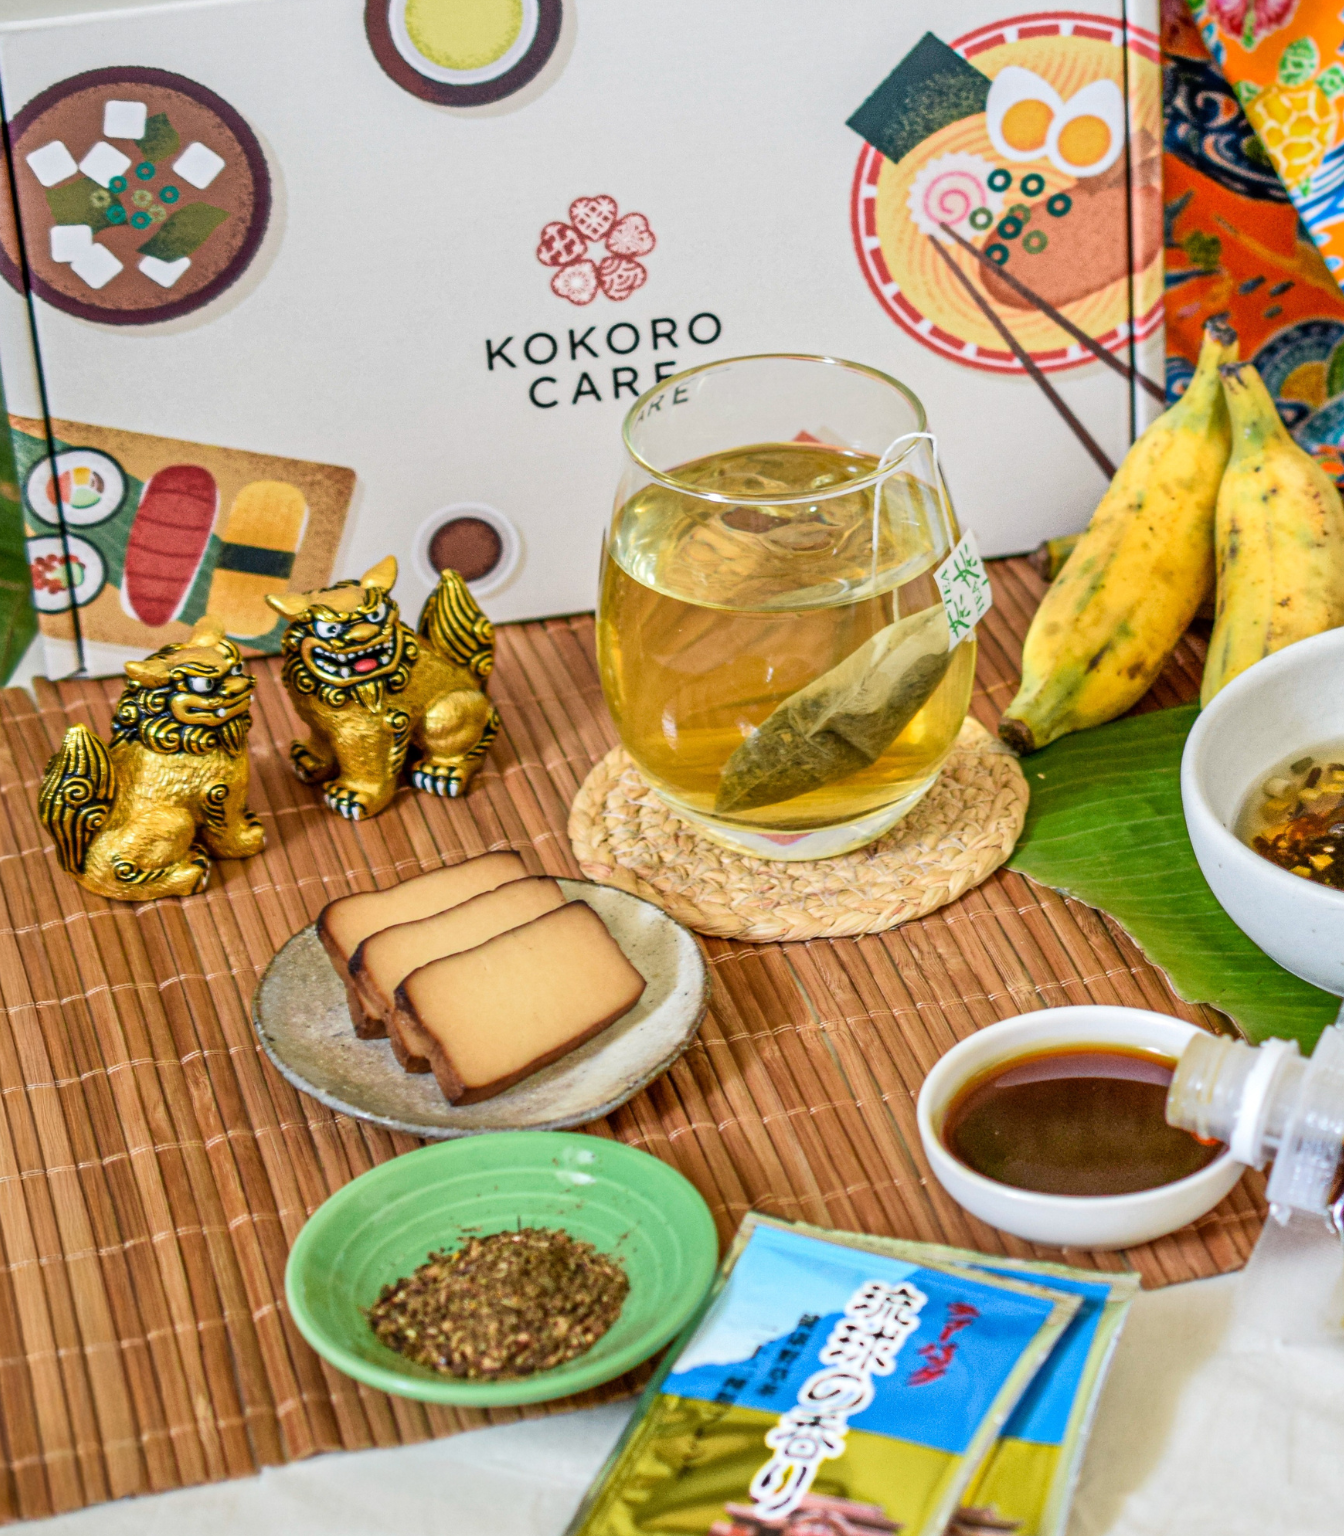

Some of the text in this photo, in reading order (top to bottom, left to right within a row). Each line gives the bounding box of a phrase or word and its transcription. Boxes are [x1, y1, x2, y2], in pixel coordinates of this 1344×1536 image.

[486, 312, 722, 371] KOKORO
[528, 361, 677, 408] CARE
[940, 568, 952, 610] TEA
[746, 1280, 928, 1520] 琉球の香り
